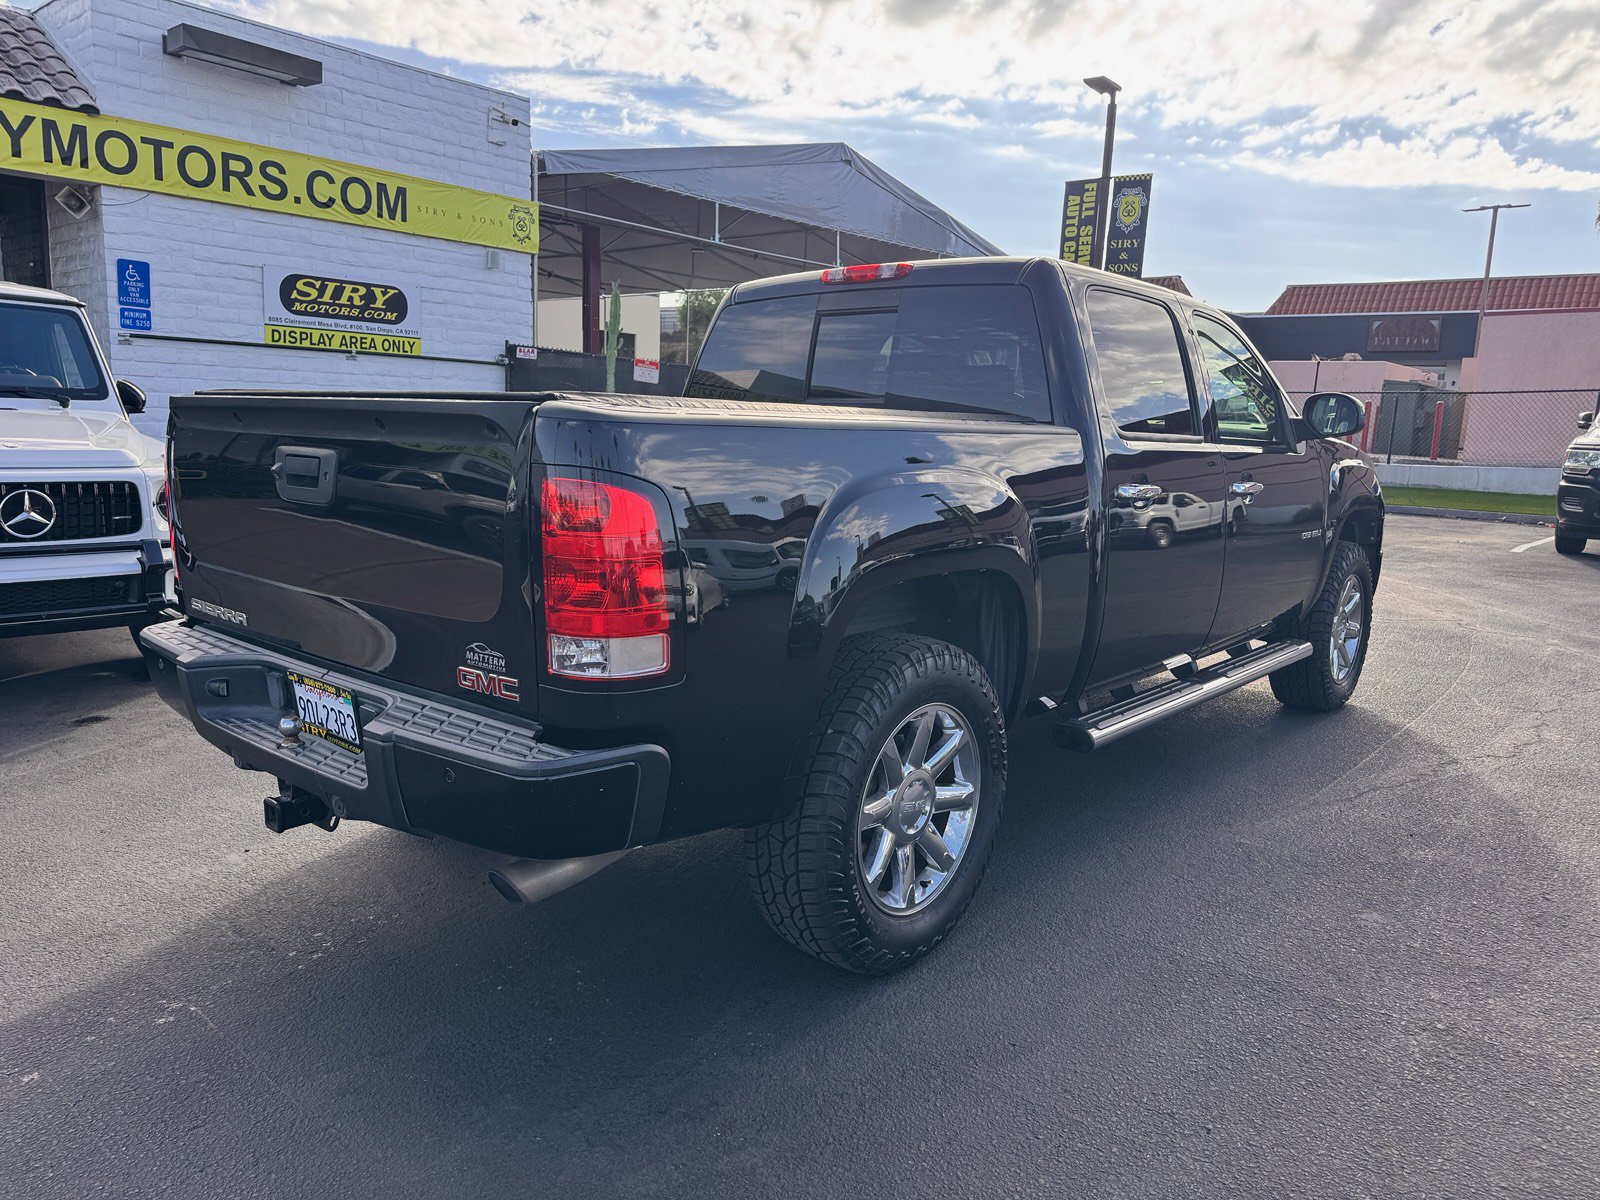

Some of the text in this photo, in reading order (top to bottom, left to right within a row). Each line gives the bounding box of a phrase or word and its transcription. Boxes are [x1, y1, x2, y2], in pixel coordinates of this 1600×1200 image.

[1081, 183, 1097, 219] FULL
[416, 205, 504, 228] SIRY & SONS
[1064, 195, 1081, 238] AUTO
[1110, 239, 1141, 249] SIRY
[1118, 251, 1129, 260] &
[1108, 263, 1139, 273] SONS
[120, 296, 150, 304] ACCESSIBLE
[290, 278, 399, 309] SIRY
[124, 311, 147, 320] MINIMUM
[291, 302, 399, 321] MOTORS.COM
[122, 318, 150, 328] FINE $250
[284, 317, 317, 327] Clairemont
[334, 322, 349, 330] Blvd,
[377, 326, 395, 334] Diego,
[271, 328, 416, 354] DISPLAY AREA ONLY
[190, 597, 248, 627] SIERRA
[466, 650, 506, 667] MATTERN
[466, 660, 506, 672] AUTOMOTIVE
[457, 666, 520, 702] GMC
